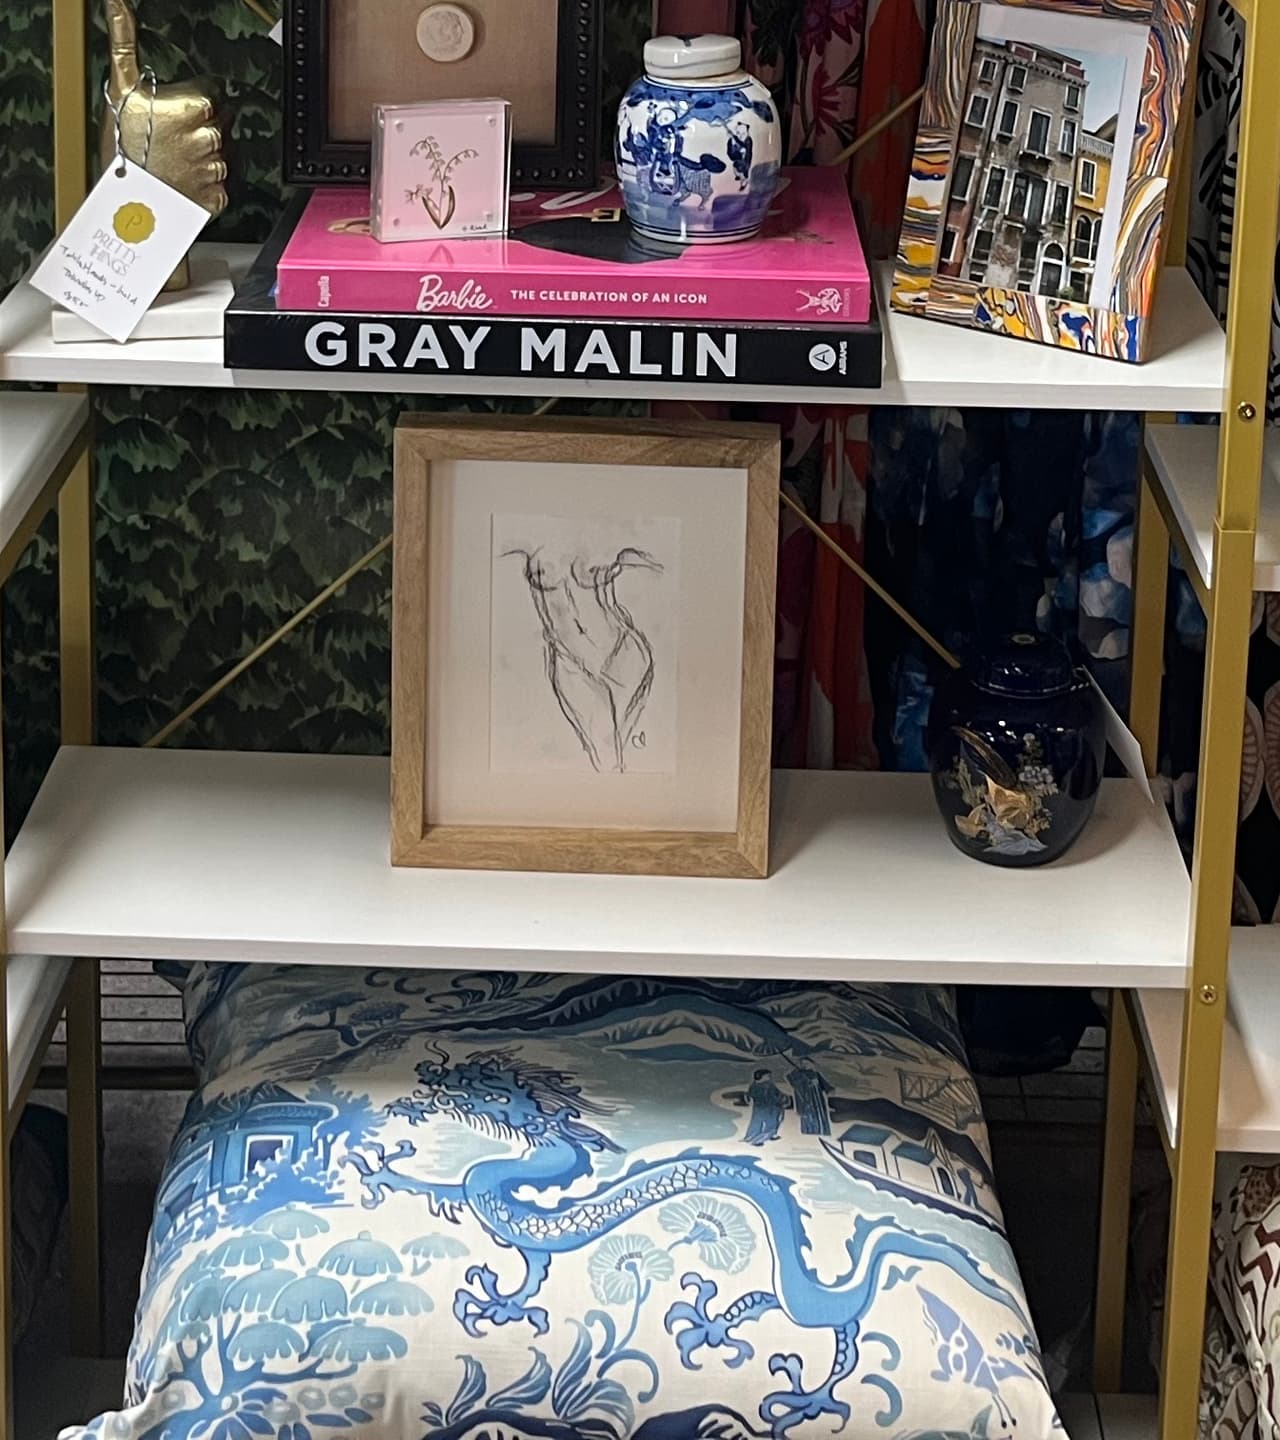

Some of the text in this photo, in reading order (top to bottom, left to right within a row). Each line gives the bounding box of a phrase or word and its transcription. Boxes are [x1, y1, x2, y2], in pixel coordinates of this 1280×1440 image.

[92, 228, 142, 264] PRETTY
[416, 274, 708, 311] Barbie THE CELEBRATION OF AN ICON
[304, 321, 737, 378] GRAY MALIN
[838, 341, 848, 376] ABRAMS
